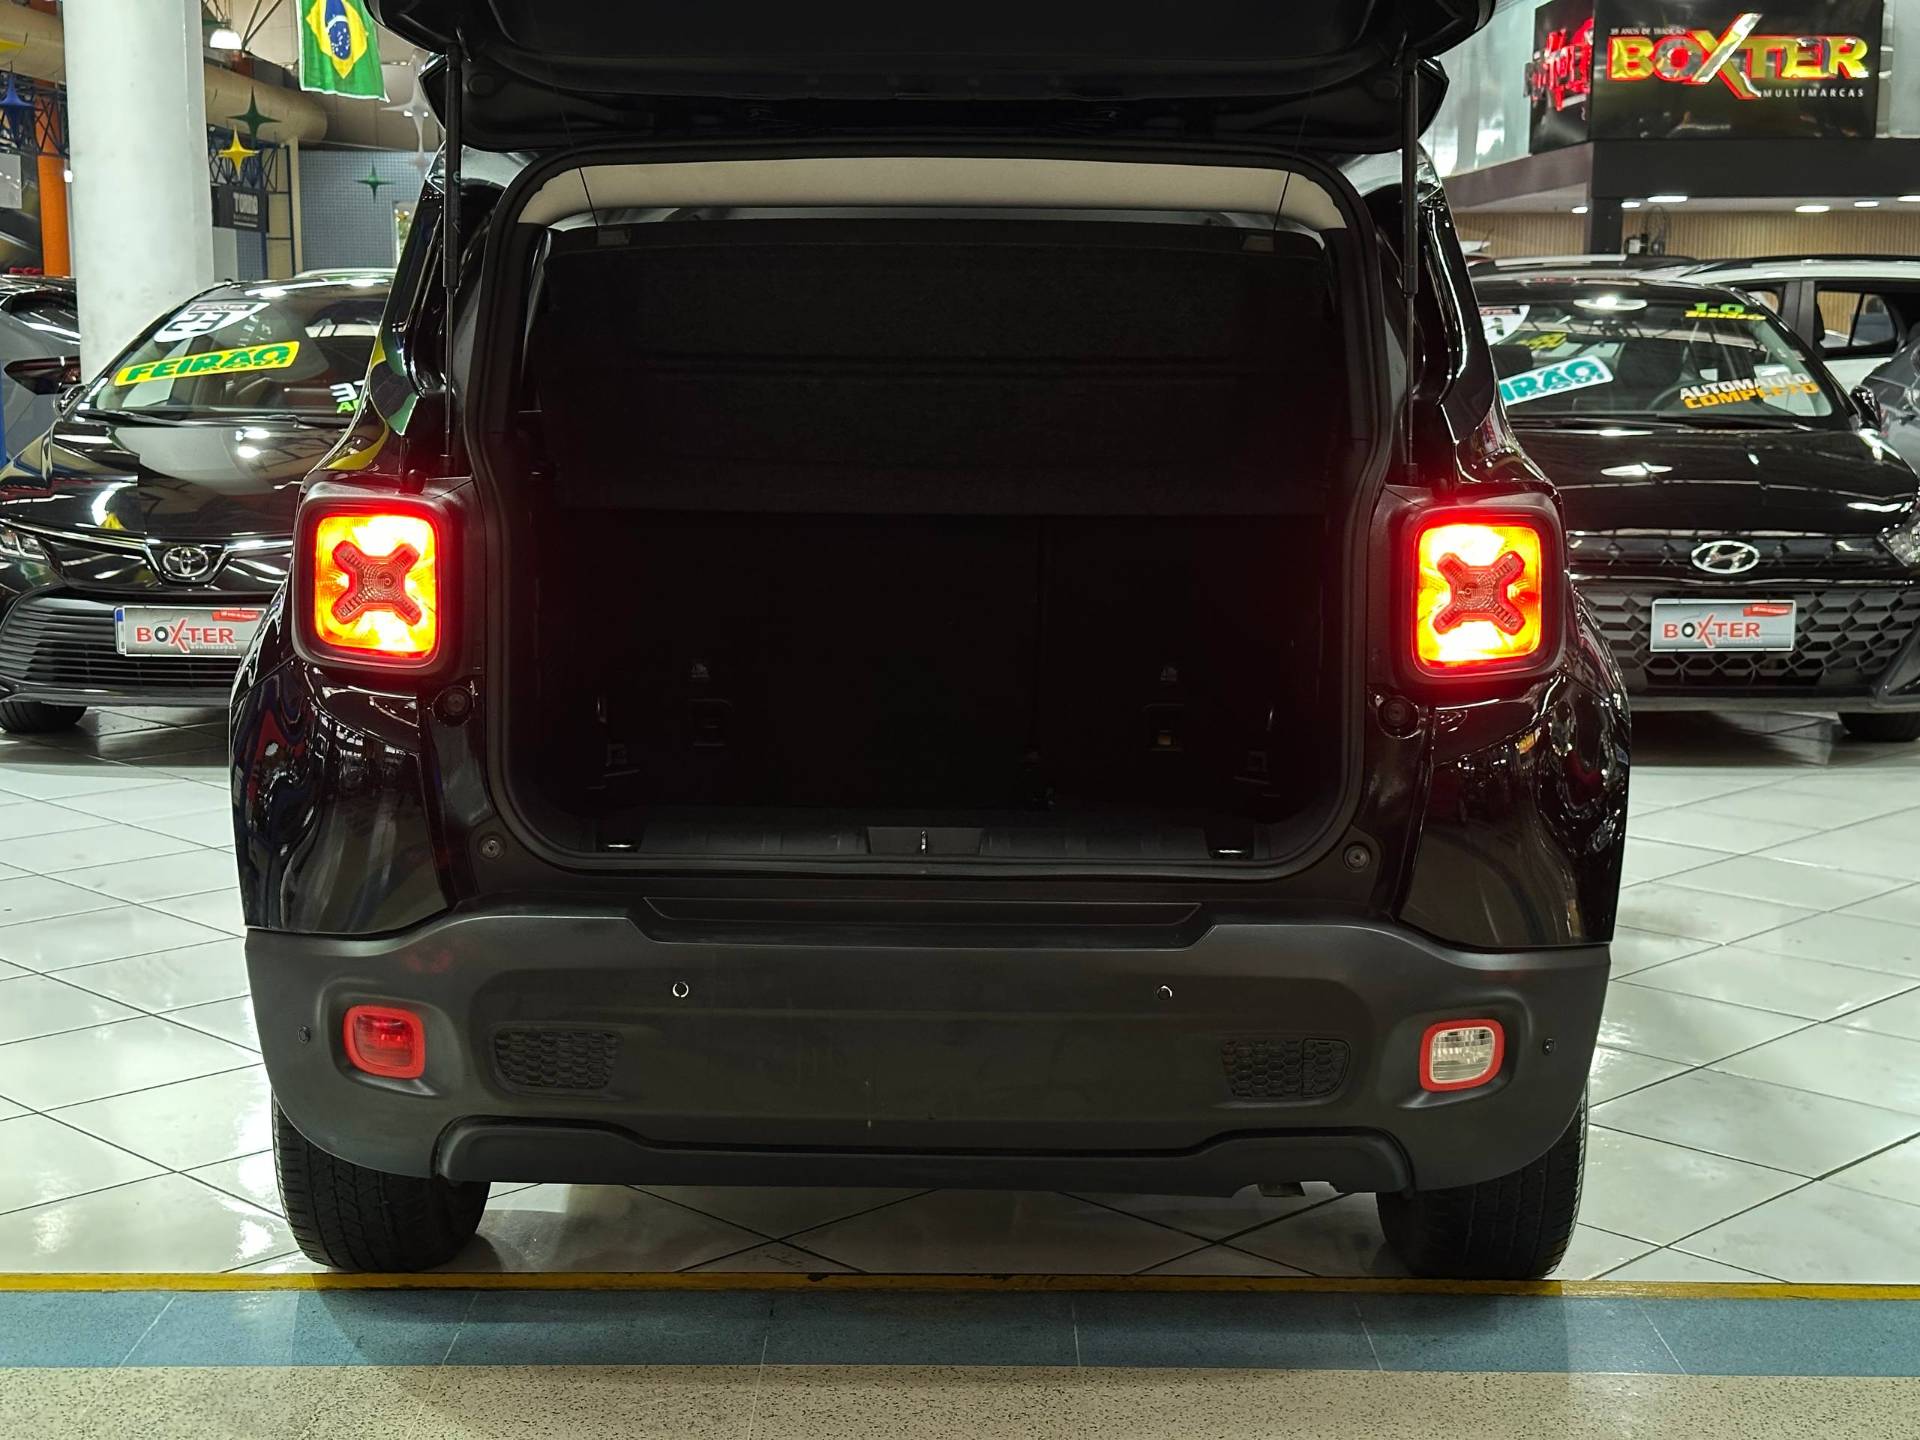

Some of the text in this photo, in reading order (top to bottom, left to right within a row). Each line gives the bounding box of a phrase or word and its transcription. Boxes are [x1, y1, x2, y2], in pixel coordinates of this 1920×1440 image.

[1606, 12, 1869, 100] BOXTER
[1763, 88, 1865, 98] MULTIMARCAS
[125, 345, 292, 382] FEIRÃO
[1683, 383, 1819, 409] COMPLETO
[136, 618, 236, 653] BOXTER
[1663, 612, 1761, 648] BOXTER
